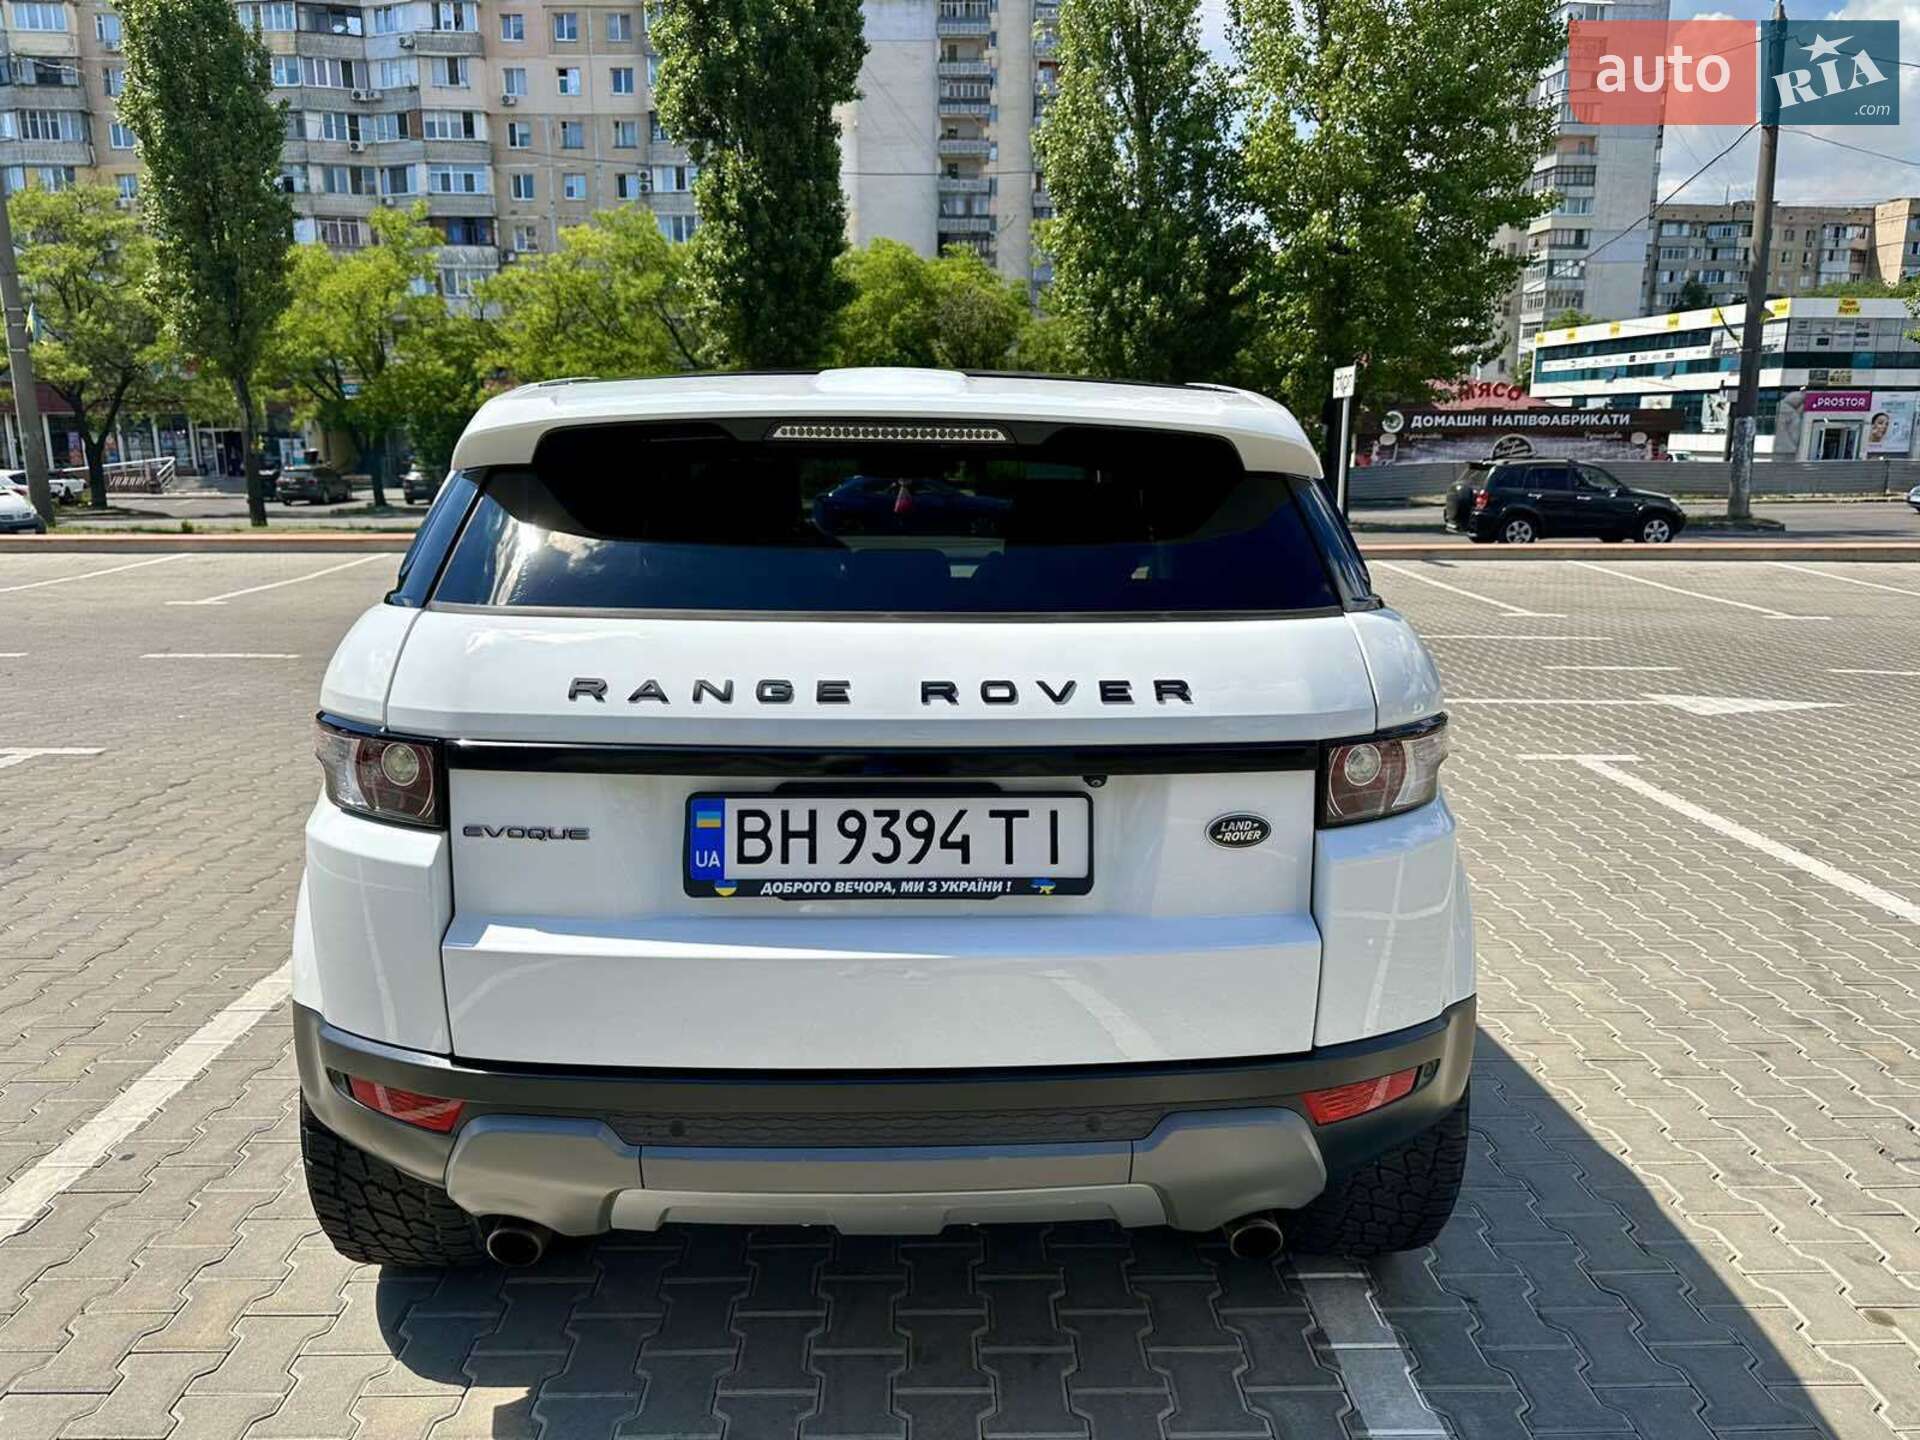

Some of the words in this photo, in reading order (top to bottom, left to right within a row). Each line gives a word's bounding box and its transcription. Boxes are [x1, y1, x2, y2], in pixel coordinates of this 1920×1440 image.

[1410, 414, 1487, 429] ДОМАШНІ
[1492, 413, 1631, 427] НАПІВФАБРИКАТИ
[567, 676, 852, 705] RANGE
[920, 678, 1193, 705] ROVER
[462, 824, 591, 841] EVOQUE
[695, 850, 720, 868] UA
[736, 808, 818, 865] BH
[836, 808, 971, 865] 9394
[988, 808, 1059, 865] TI
[760, 881, 832, 895] ДОБРОГО
[834, 881, 896, 895] ВЕЧОРА,
[899, 881, 925, 893] МИ
[940, 879, 1003, 893] УКРАЇНИ
[1006, 880, 1012, 892] !
